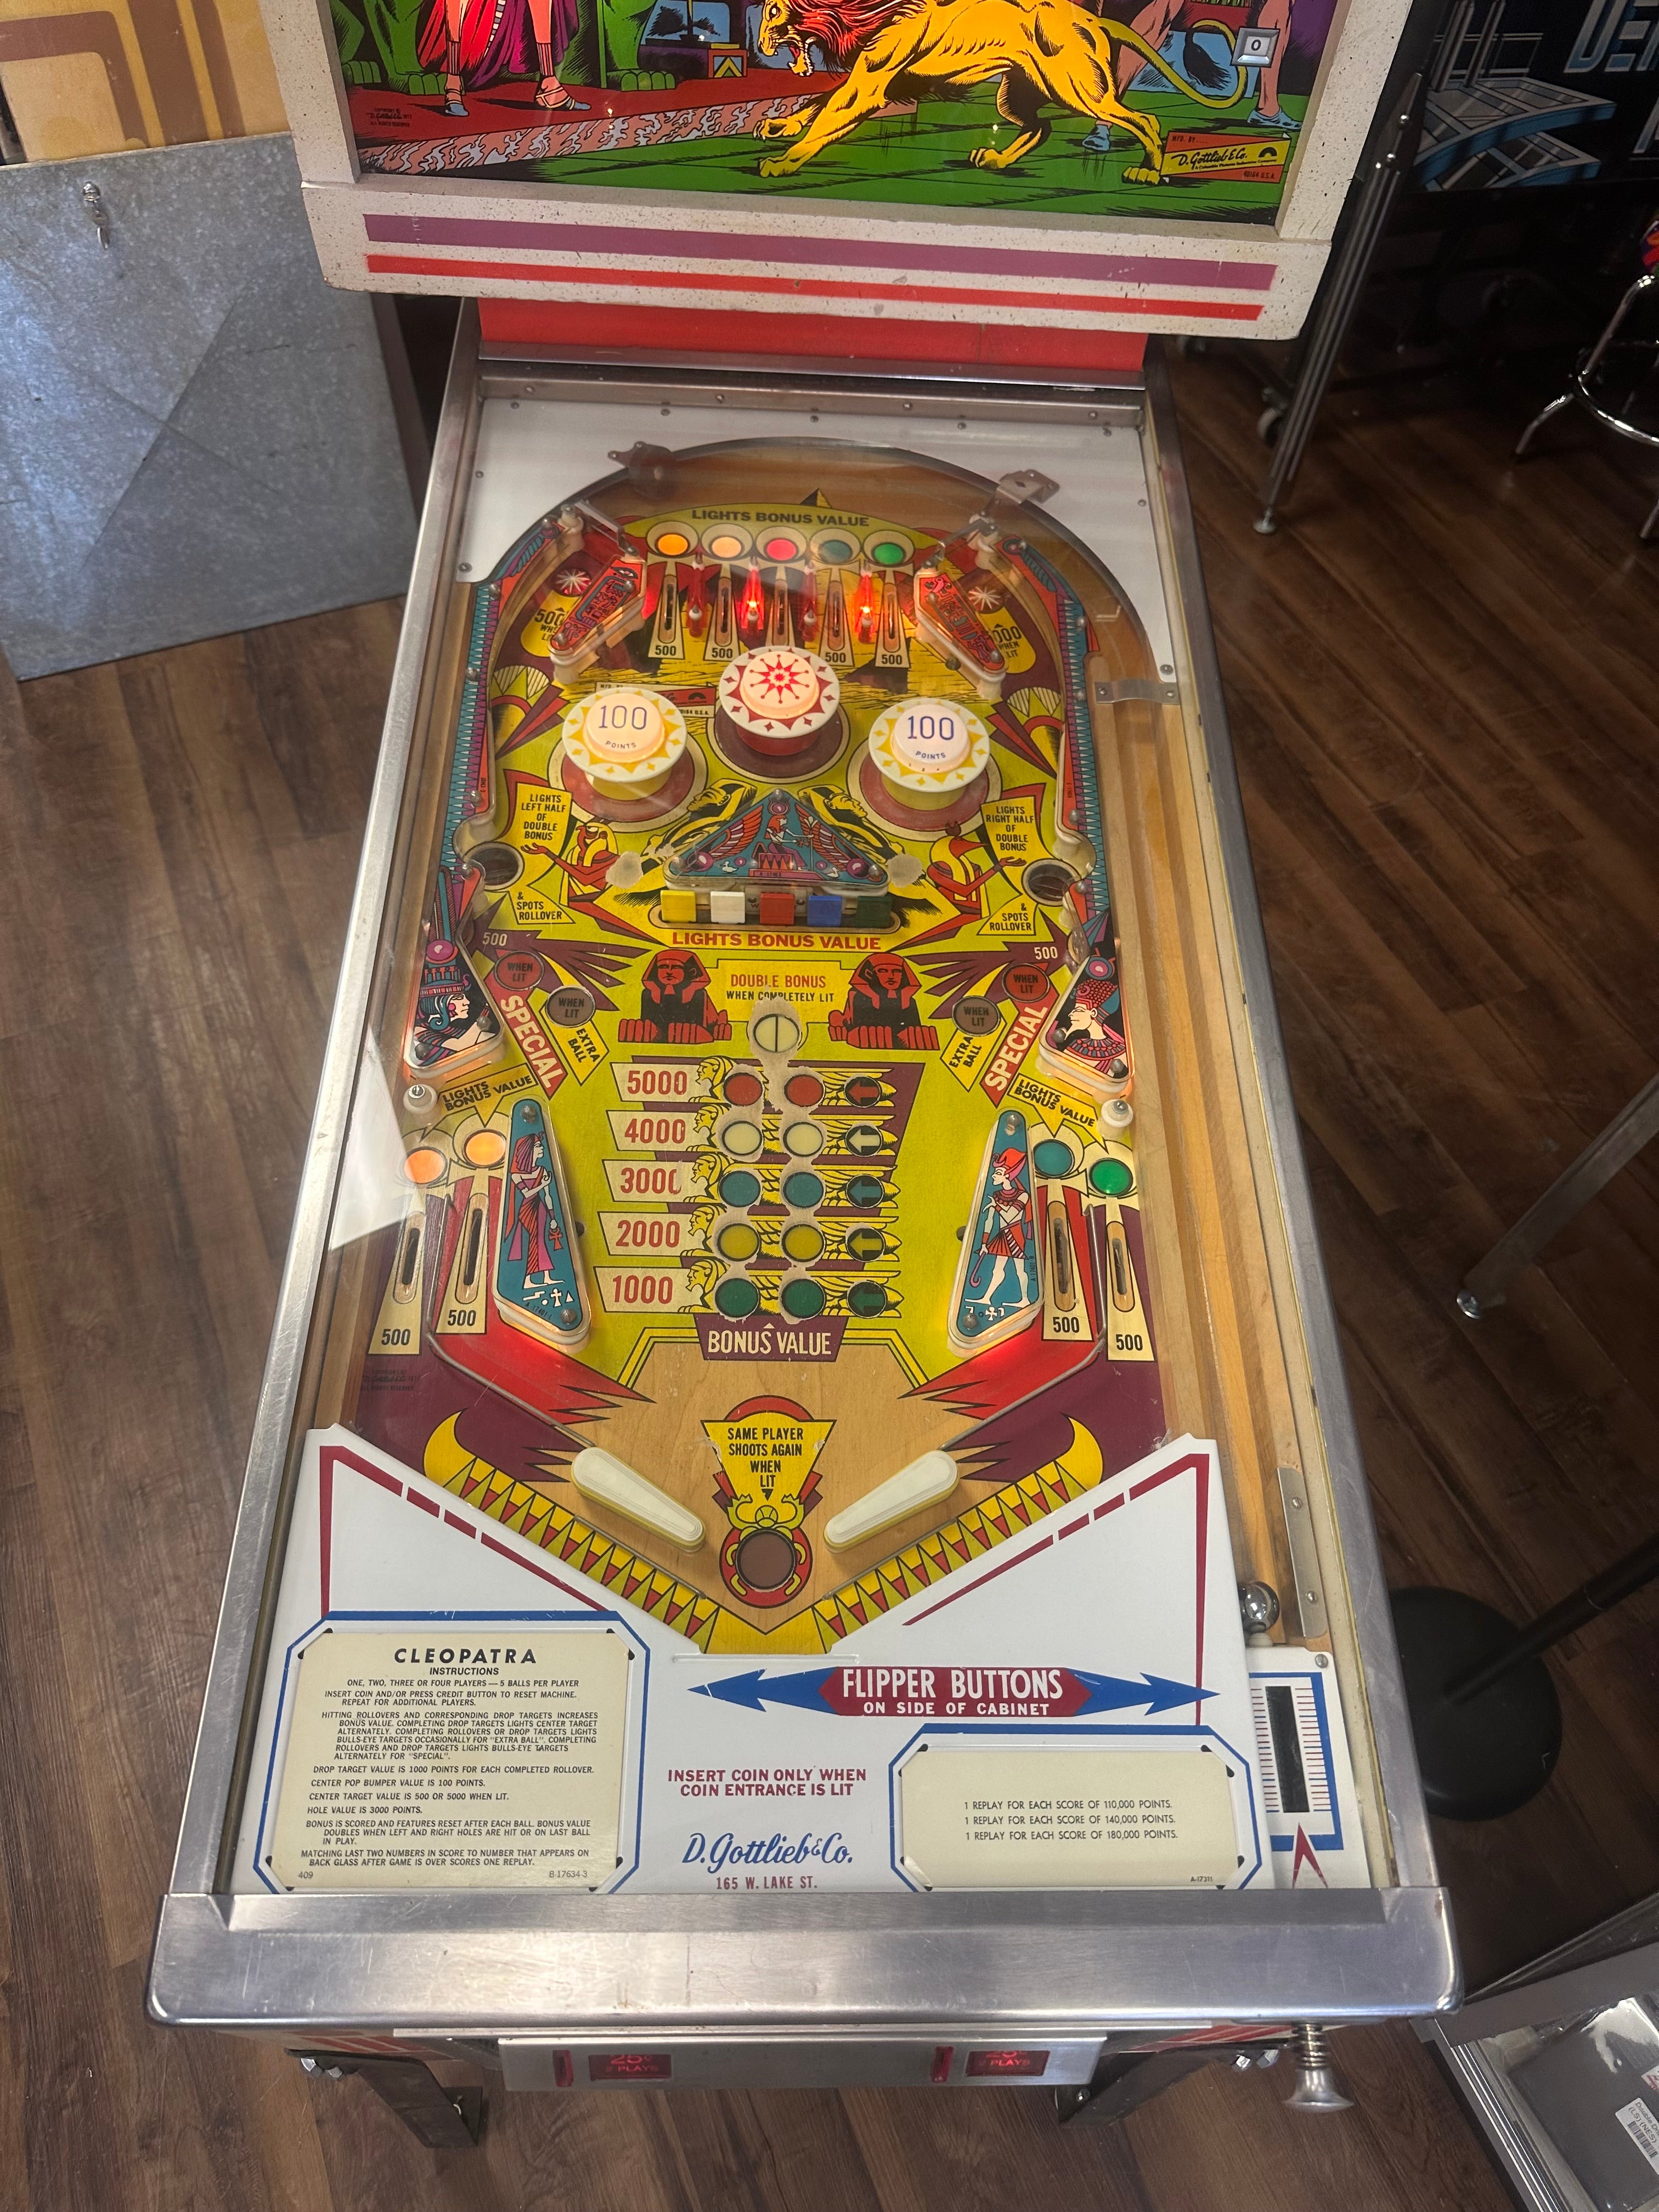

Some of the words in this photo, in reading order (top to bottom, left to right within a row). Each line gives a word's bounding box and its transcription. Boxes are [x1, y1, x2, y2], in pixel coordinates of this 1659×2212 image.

[1564, 0, 1659, 73] DE
[1251, 40, 1261, 50] 0
[692, 510, 751, 521] LIGHTS
[755, 512, 812, 523] BONUS
[817, 515, 869, 526] VALUE
[655, 645, 676, 656] 500
[712, 647, 733, 658] 500
[825, 652, 846, 663] 500
[882, 654, 902, 665] 500
[599, 706, 647, 730] 100
[907, 715, 954, 741] 100
[606, 741, 637, 749] POINTS
[916, 751, 946, 760] POINTS
[529, 794, 562, 803] LIGHTS
[521, 802, 541, 811] LEFT
[996, 806, 1025, 814] LIGHTS
[986, 815, 1011, 823] RIGHT
[1013, 815, 1034, 823] HALF
[523, 821, 557, 831] DOUBLE
[524, 832, 553, 840] BONUS
[996, 834, 1028, 843] DOUBLE
[1000, 843, 1026, 851] BONUS
[518, 891, 524, 900] &
[517, 901, 544, 910] SPOTS
[1021, 903, 1027, 911] &
[518, 911, 562, 920] ROLLOVER
[1002, 913, 1029, 922] SPOTS
[989, 922, 1031, 931] ROLLOVER
[482, 932, 507, 946] 500
[672, 933, 742, 946] LIGHTS
[748, 934, 814, 948] BONUS
[819, 936, 881, 950] VALUE
[1034, 946, 1058, 960] 500
[508, 962, 533, 972] WHEN
[512, 973, 527, 981] LIT
[731, 974, 779, 988] DOUBLE
[785, 975, 826, 988] BONUS
[1013, 974, 1038, 983] WHEN
[1020, 985, 1034, 994] LIT
[559, 997, 584, 1007] WHEN
[726, 991, 754, 1000] WHEN
[758, 991, 815, 1001] COMPLETELY
[820, 993, 834, 1002] LIT
[565, 1009, 579, 1018] LIT
[964, 1006, 988, 1015] WHEN
[972, 1017, 985, 1026] LIT
[500, 995, 563, 1088] SPECIAL
[576, 1028, 601, 1063] EXTRA
[568, 1038, 587, 1063] BALL
[949, 1036, 973, 1068] EXTRA
[985, 1007, 1048, 1091] SPECIAL
[963, 1044, 982, 1068] BALL
[627, 1070, 687, 1095] 5000
[442, 1081, 489, 1103] LIGHTS
[445, 1090, 491, 1111] BONUS
[492, 1075, 533, 1094] VALUE
[1019, 1079, 1062, 1103] LIGHTS
[1014, 1088, 1056, 1110] BONUS
[1059, 1105, 1096, 1127] VALUE
[624, 1118, 685, 1144] 4000
[620, 1167, 682, 1194] 3000
[616, 1220, 680, 1248] 2000
[613, 1274, 673, 1304] 1000
[448, 1310, 476, 1326] 500
[1053, 1317, 1080, 1333] 500
[381, 1329, 410, 1345] 500
[707, 1330, 771, 1354] BONUS
[778, 1332, 832, 1355] VALUE
[1116, 1334, 1143, 1351] 500
[727, 1427, 758, 1440] SAME
[763, 1427, 804, 1440] PLAYER
[729, 1443, 768, 1456] SHOOTS
[771, 1444, 802, 1456] AGAIN
[750, 1460, 781, 1472] WHEN
[760, 1475, 776, 1487] LIT
[394, 1648, 537, 1664] CLEOPATRA
[430, 1667, 499, 1675] INSTRUCTIONS
[843, 1669, 936, 1698] FLIPPER
[951, 1669, 1063, 1699] BUTTONS
[863, 1701, 885, 1713] ON
[896, 1702, 935, 1714] SIDE
[946, 1702, 965, 1714] OF
[977, 1703, 1049, 1716] CABINET
[668, 1769, 726, 1782] INSERT
[731, 1769, 769, 1781] COIN
[774, 1769, 814, 1781] ONLY
[820, 1768, 866, 1781] WHEN
[681, 1784, 719, 1796] COIN
[725, 1784, 805, 1796] ENTRANCE
[811, 1784, 825, 1796] IS
[831, 1783, 853, 1796] LIT
[973, 1801, 1003, 1810] REPLAY
[1008, 1801, 1025, 1809] FOR
[1029, 1801, 1052, 1809] EACH
[1056, 1800, 1084, 1809] SCORE
[1088, 1800, 1100, 1809] OF
[1104, 1800, 1135, 1810] 110,000
[1139, 1799, 1172, 1809] POINTS.
[716, 1877, 738, 1890] 165
[746, 1877, 759, 1889] W.
[764, 1876, 793, 1889] LAKE
[800, 1876, 817, 1889] ST.
